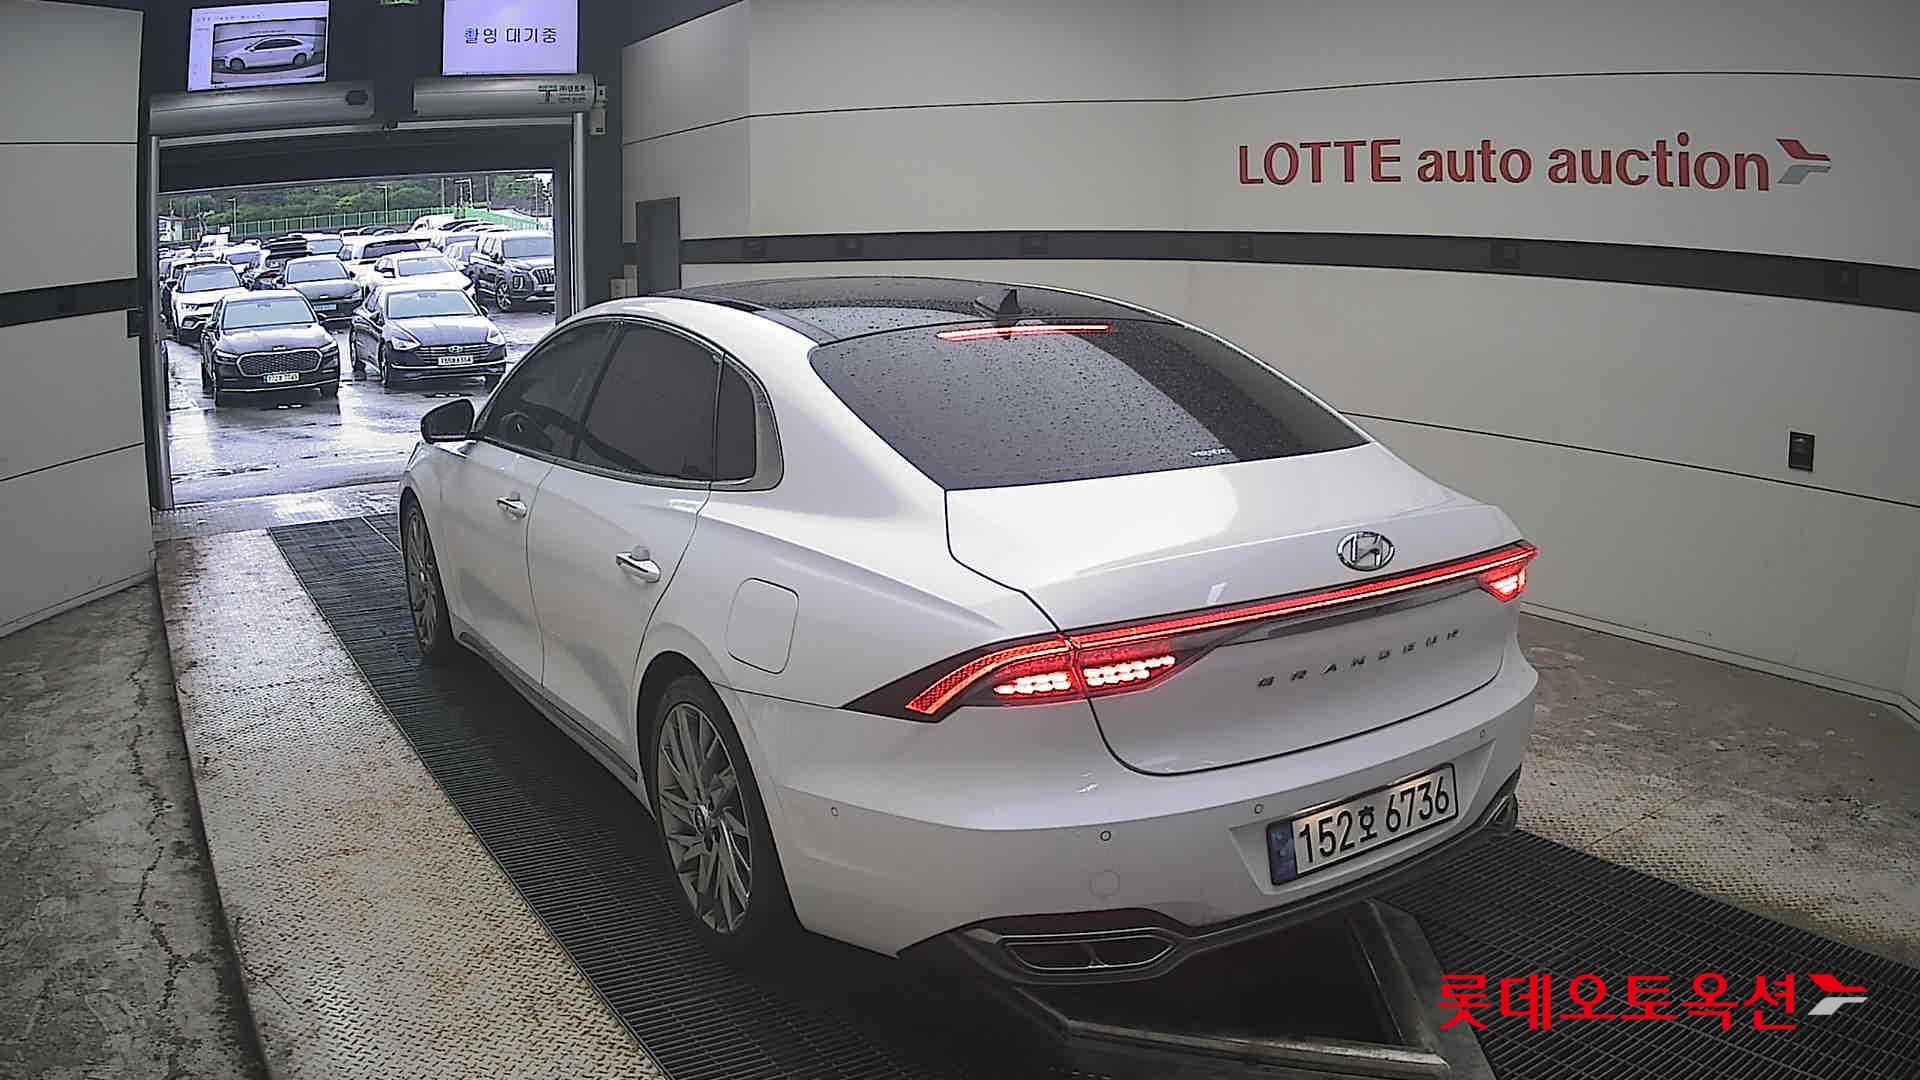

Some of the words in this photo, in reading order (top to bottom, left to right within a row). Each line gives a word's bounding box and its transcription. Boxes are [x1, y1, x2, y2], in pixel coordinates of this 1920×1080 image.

[464, 27, 497, 44] 촬영
[505, 27, 557, 44] 대기중
[1238, 138, 1401, 185] LOTTE
[1416, 139, 1533, 184] auto
[1547, 132, 1771, 192] auction
[1256, 628, 1460, 688] GRANDEUR
[1298, 805, 1379, 864] 152호
[1385, 775, 1451, 833] 6736
